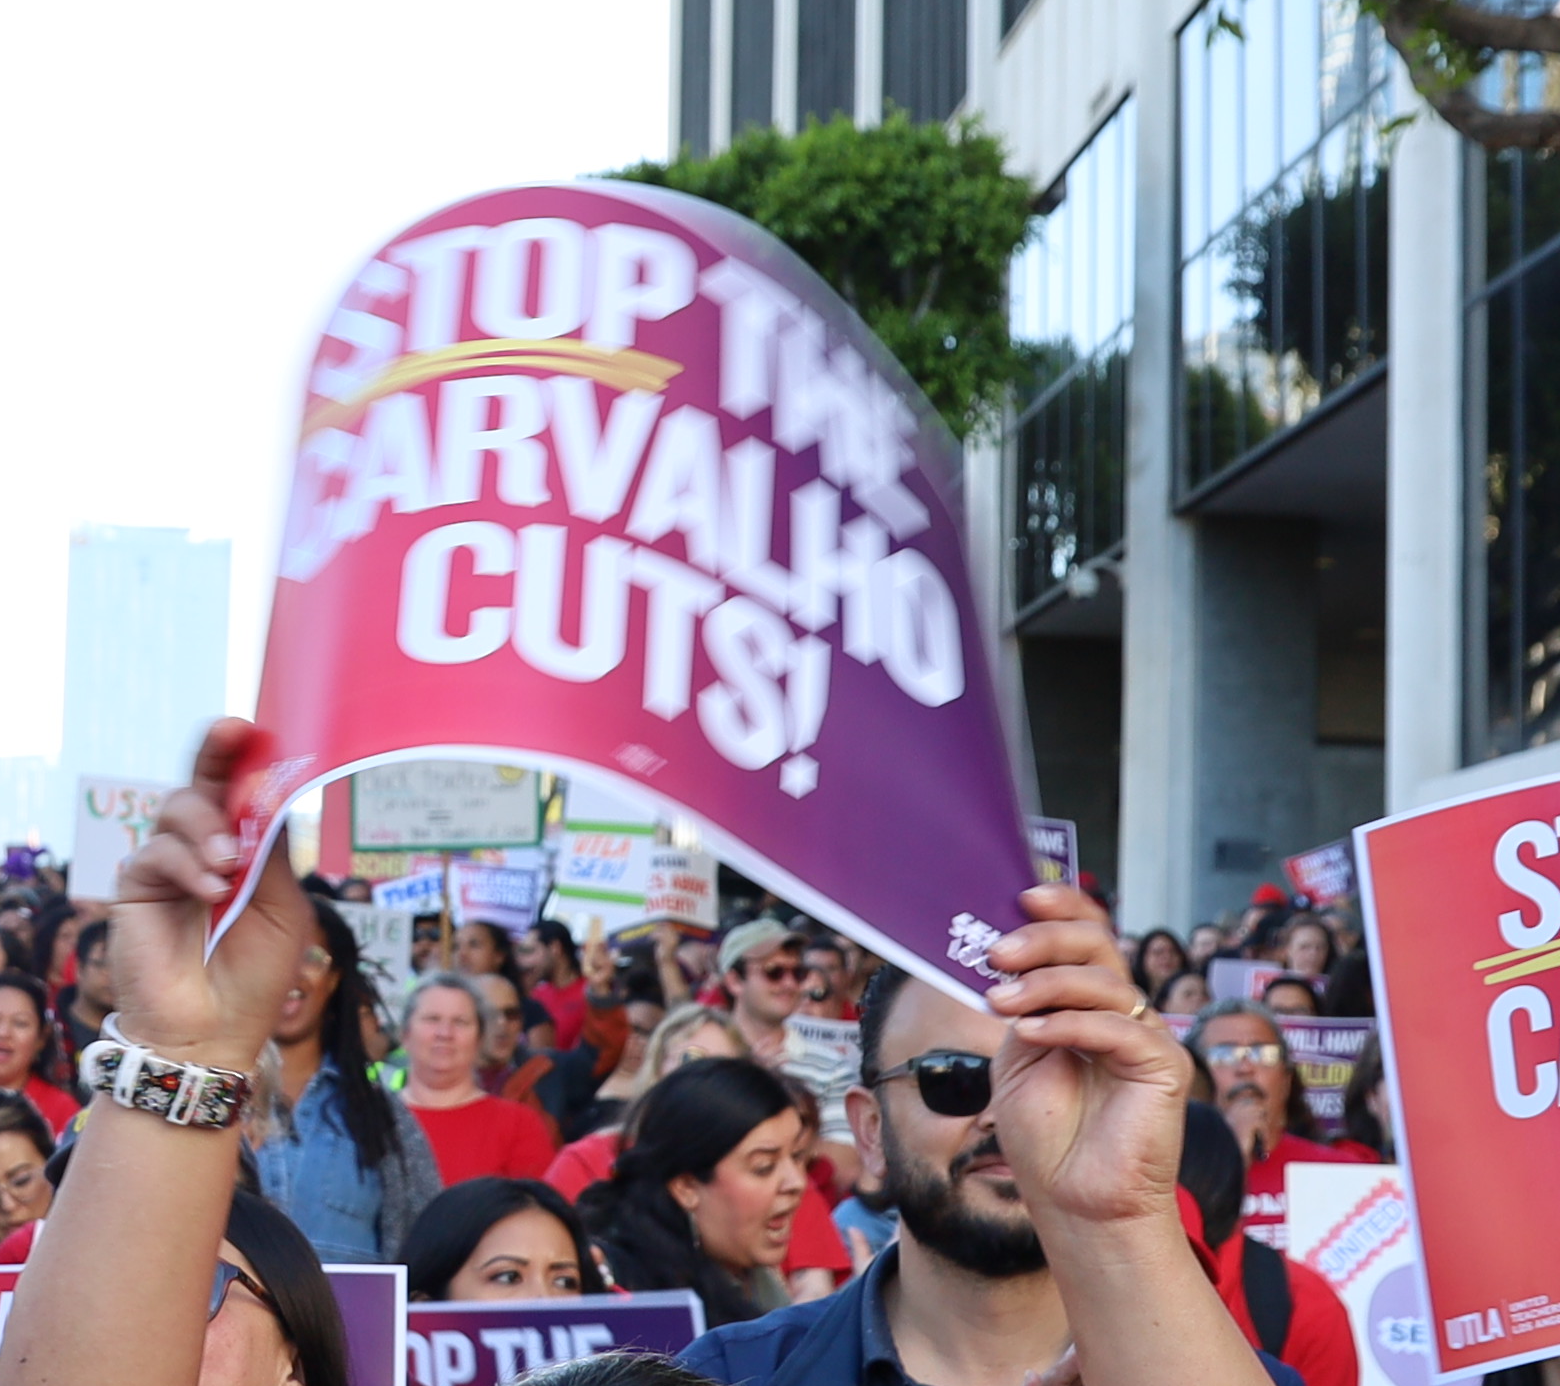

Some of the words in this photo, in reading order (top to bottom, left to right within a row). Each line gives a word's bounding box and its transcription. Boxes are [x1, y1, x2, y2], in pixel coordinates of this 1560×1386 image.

[309, 216, 700, 404] STOP
[700, 253, 932, 539] THE
[278, 371, 964, 707] CARVALHO
[396, 519, 832, 801] CUTS!
[1444, 1307, 1507, 1351] UTLA
